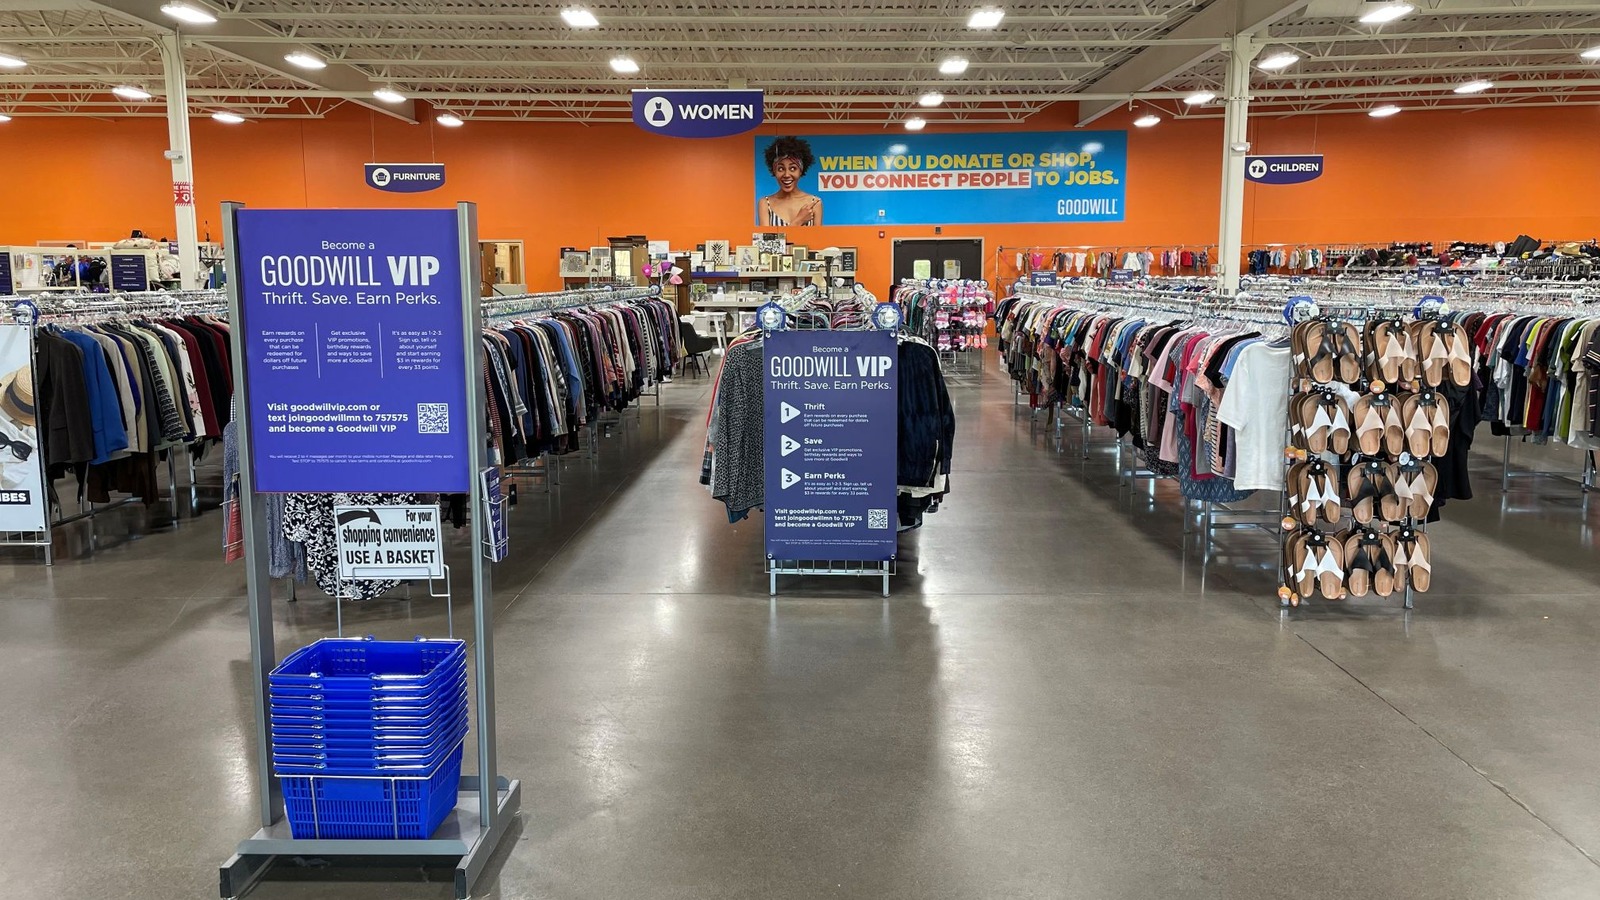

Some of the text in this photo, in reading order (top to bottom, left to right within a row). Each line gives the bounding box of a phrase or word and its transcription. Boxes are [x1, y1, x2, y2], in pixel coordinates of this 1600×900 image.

[679, 104, 754, 120] WOMEN
[820, 152, 1095, 170] WHEN YOU DONATE OR SHOP,
[1270, 163, 1319, 172] CHILDREN
[819, 170, 1119, 188] YOU CONNECT PEOPLE TO JOBS.
[1057, 199, 1118, 215] GOODWILL
[322, 240, 375, 250] Become a
[261, 255, 440, 286] GOODWILL VIP
[262, 292, 440, 305] Thrift. Save. Earn Perks.
[771, 356, 892, 377] GOODWILL VIP
[771, 380, 891, 390] Thrift. Save. Earn Perks.
[267, 403, 288, 411] Visit
[290, 403, 368, 412] goodwillvip.com
[268, 414, 408, 423] text joingoodwillmn to 757575
[268, 424, 286, 432] and
[336, 424, 378, 432] Goodwill
[380, 424, 397, 432] VIP
[406, 510, 432, 524] For your
[343, 525, 435, 547] shopping convenience
[346, 550, 435, 564] USE A BASKET
